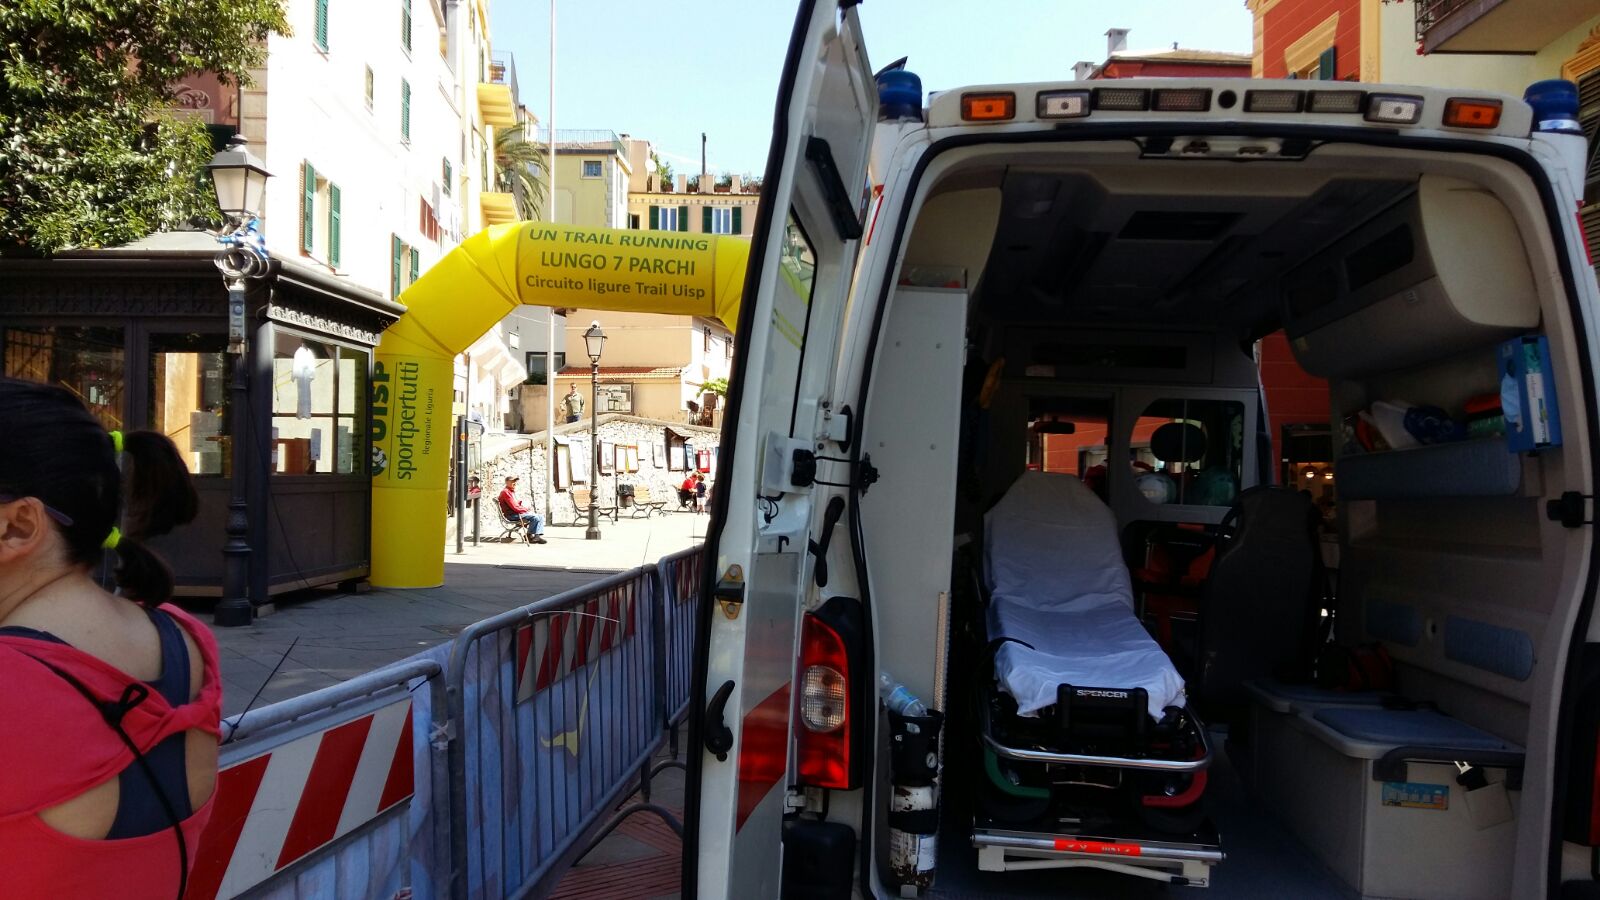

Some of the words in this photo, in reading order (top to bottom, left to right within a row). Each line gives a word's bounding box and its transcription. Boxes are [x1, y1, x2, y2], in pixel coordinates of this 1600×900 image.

[529, 229, 558, 241] UN
[564, 231, 613, 245] TRAIL
[619, 235, 709, 251] RUNNING
[541, 251, 607, 270] LUNGO
[612, 256, 624, 271] 7
[629, 257, 696, 276] PARCHI
[525, 274, 584, 291] Circuito
[588, 278, 631, 294] ligure
[635, 281, 667, 296] Trail
[672, 284, 706, 300] Uisp
[424, 388, 434, 415] Liguria
[396, 361, 420, 480] sportpertutti
[422, 417, 433, 455] Regionale
[1076, 689, 1128, 698] SPENCER
